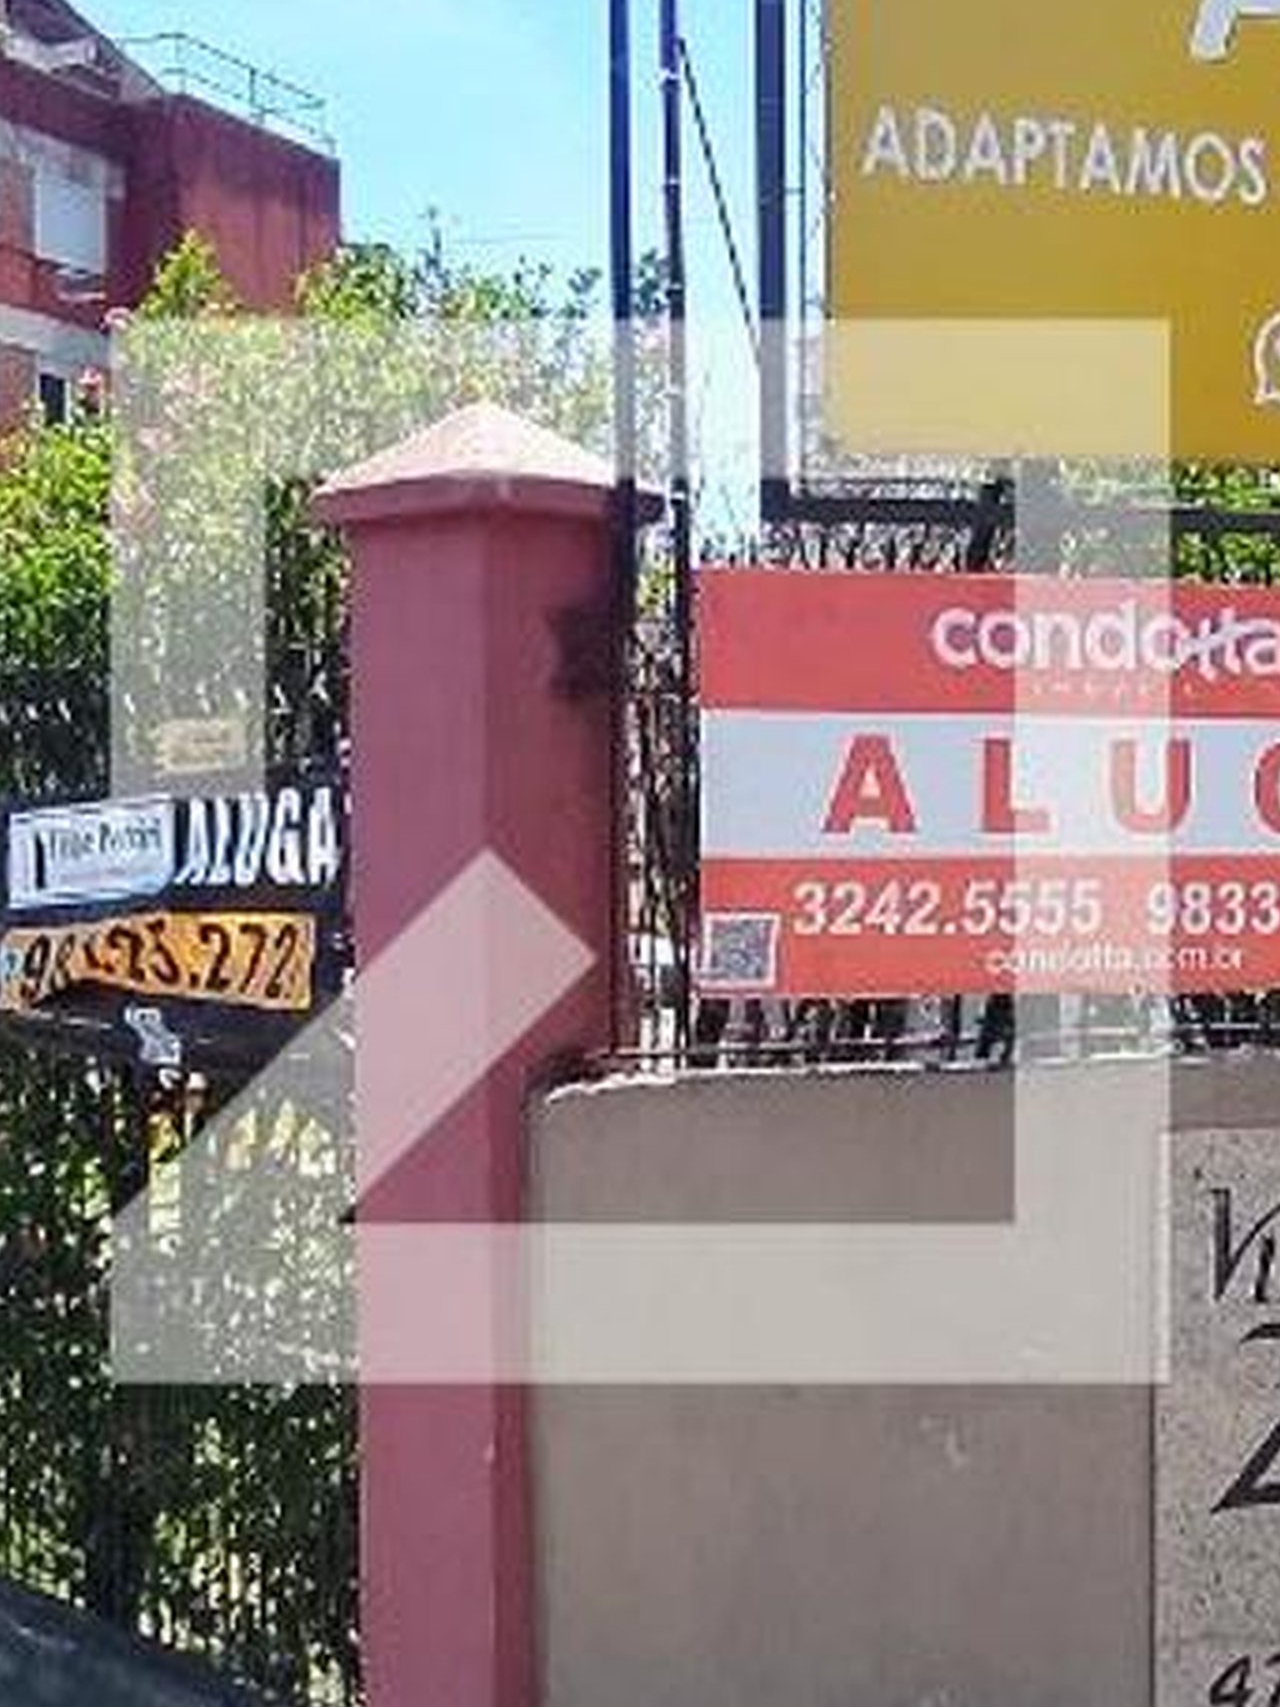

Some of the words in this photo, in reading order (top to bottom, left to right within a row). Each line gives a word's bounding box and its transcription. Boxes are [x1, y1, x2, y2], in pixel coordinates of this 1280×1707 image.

[862, 105, 1269, 207] ADAPTAMOS
[174, 786, 342, 886] ALUGA
[794, 879, 1104, 937] 3242.5555
